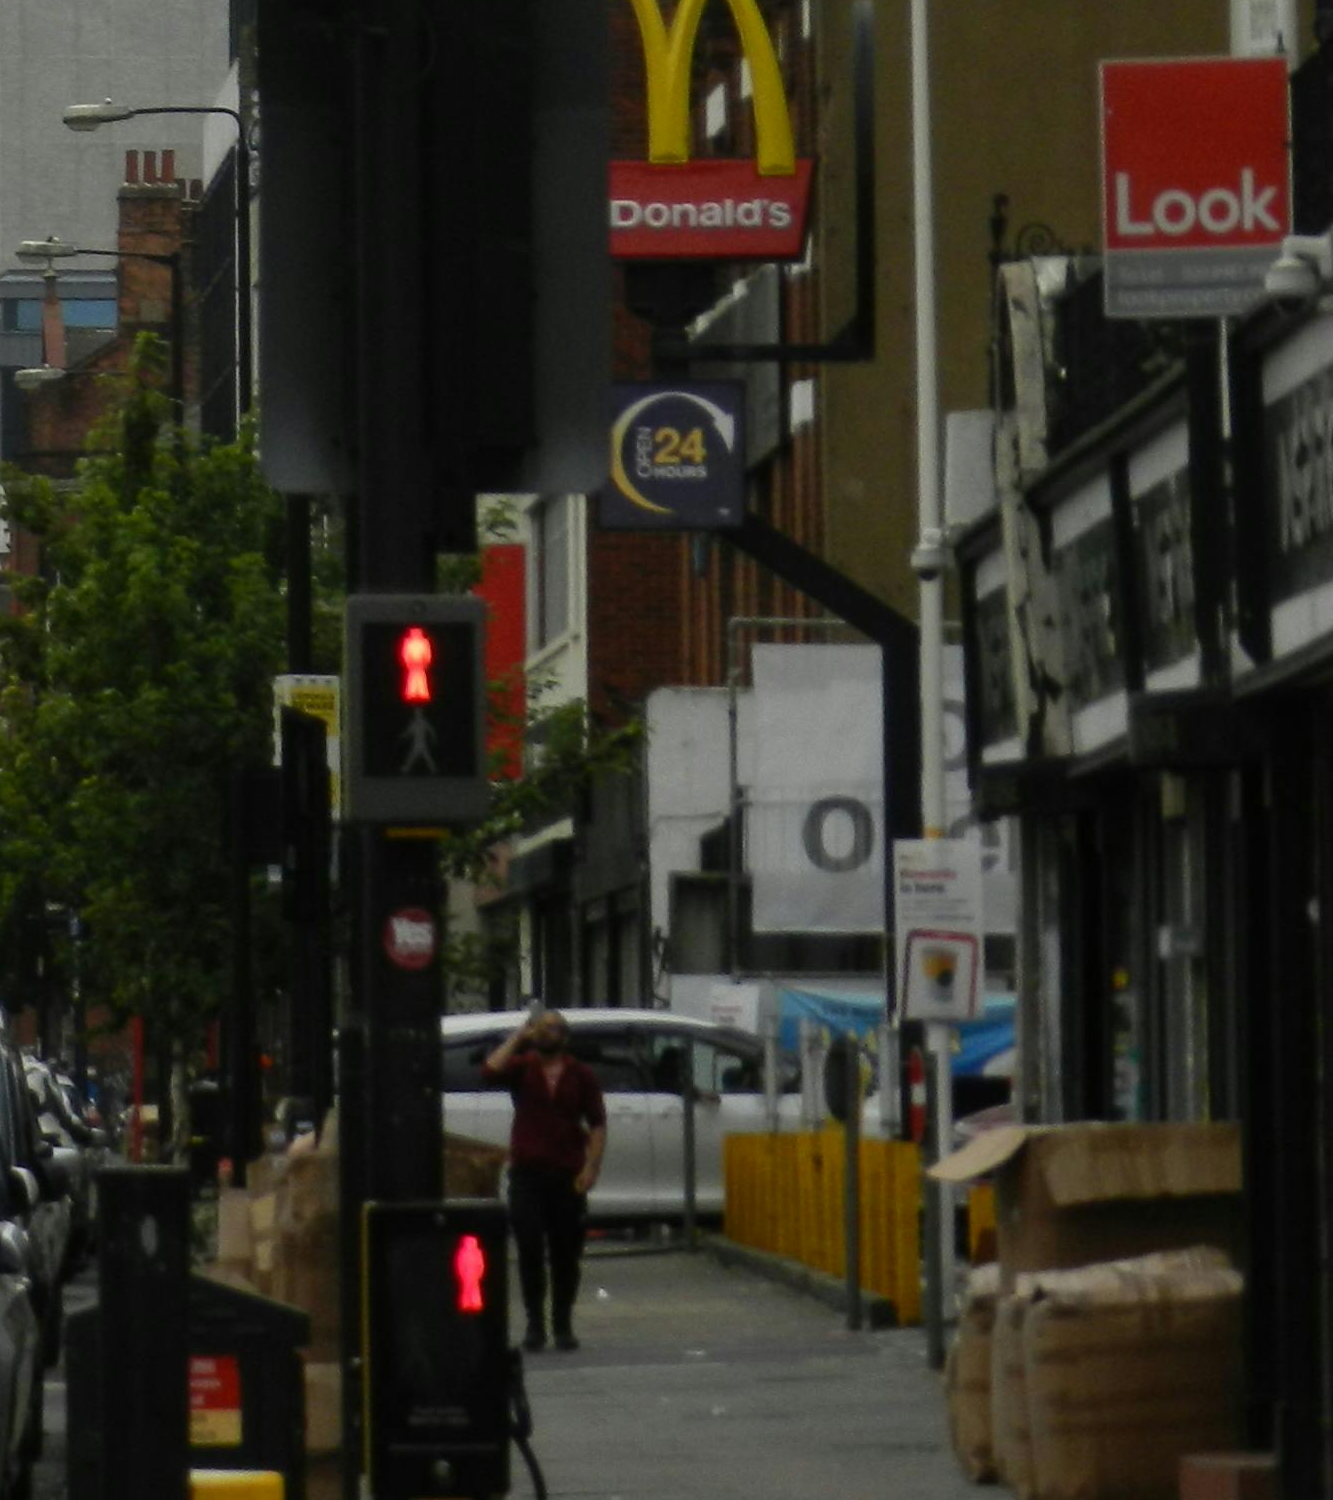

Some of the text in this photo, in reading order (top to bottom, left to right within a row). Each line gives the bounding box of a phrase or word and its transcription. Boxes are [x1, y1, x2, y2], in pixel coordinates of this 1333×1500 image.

[609, 199, 792, 229] Donald's
[1116, 167, 1281, 236] Look
[636, 426, 652, 478] OPEN
[654, 426, 706, 465] 24
[655, 465, 707, 478] HOURS
